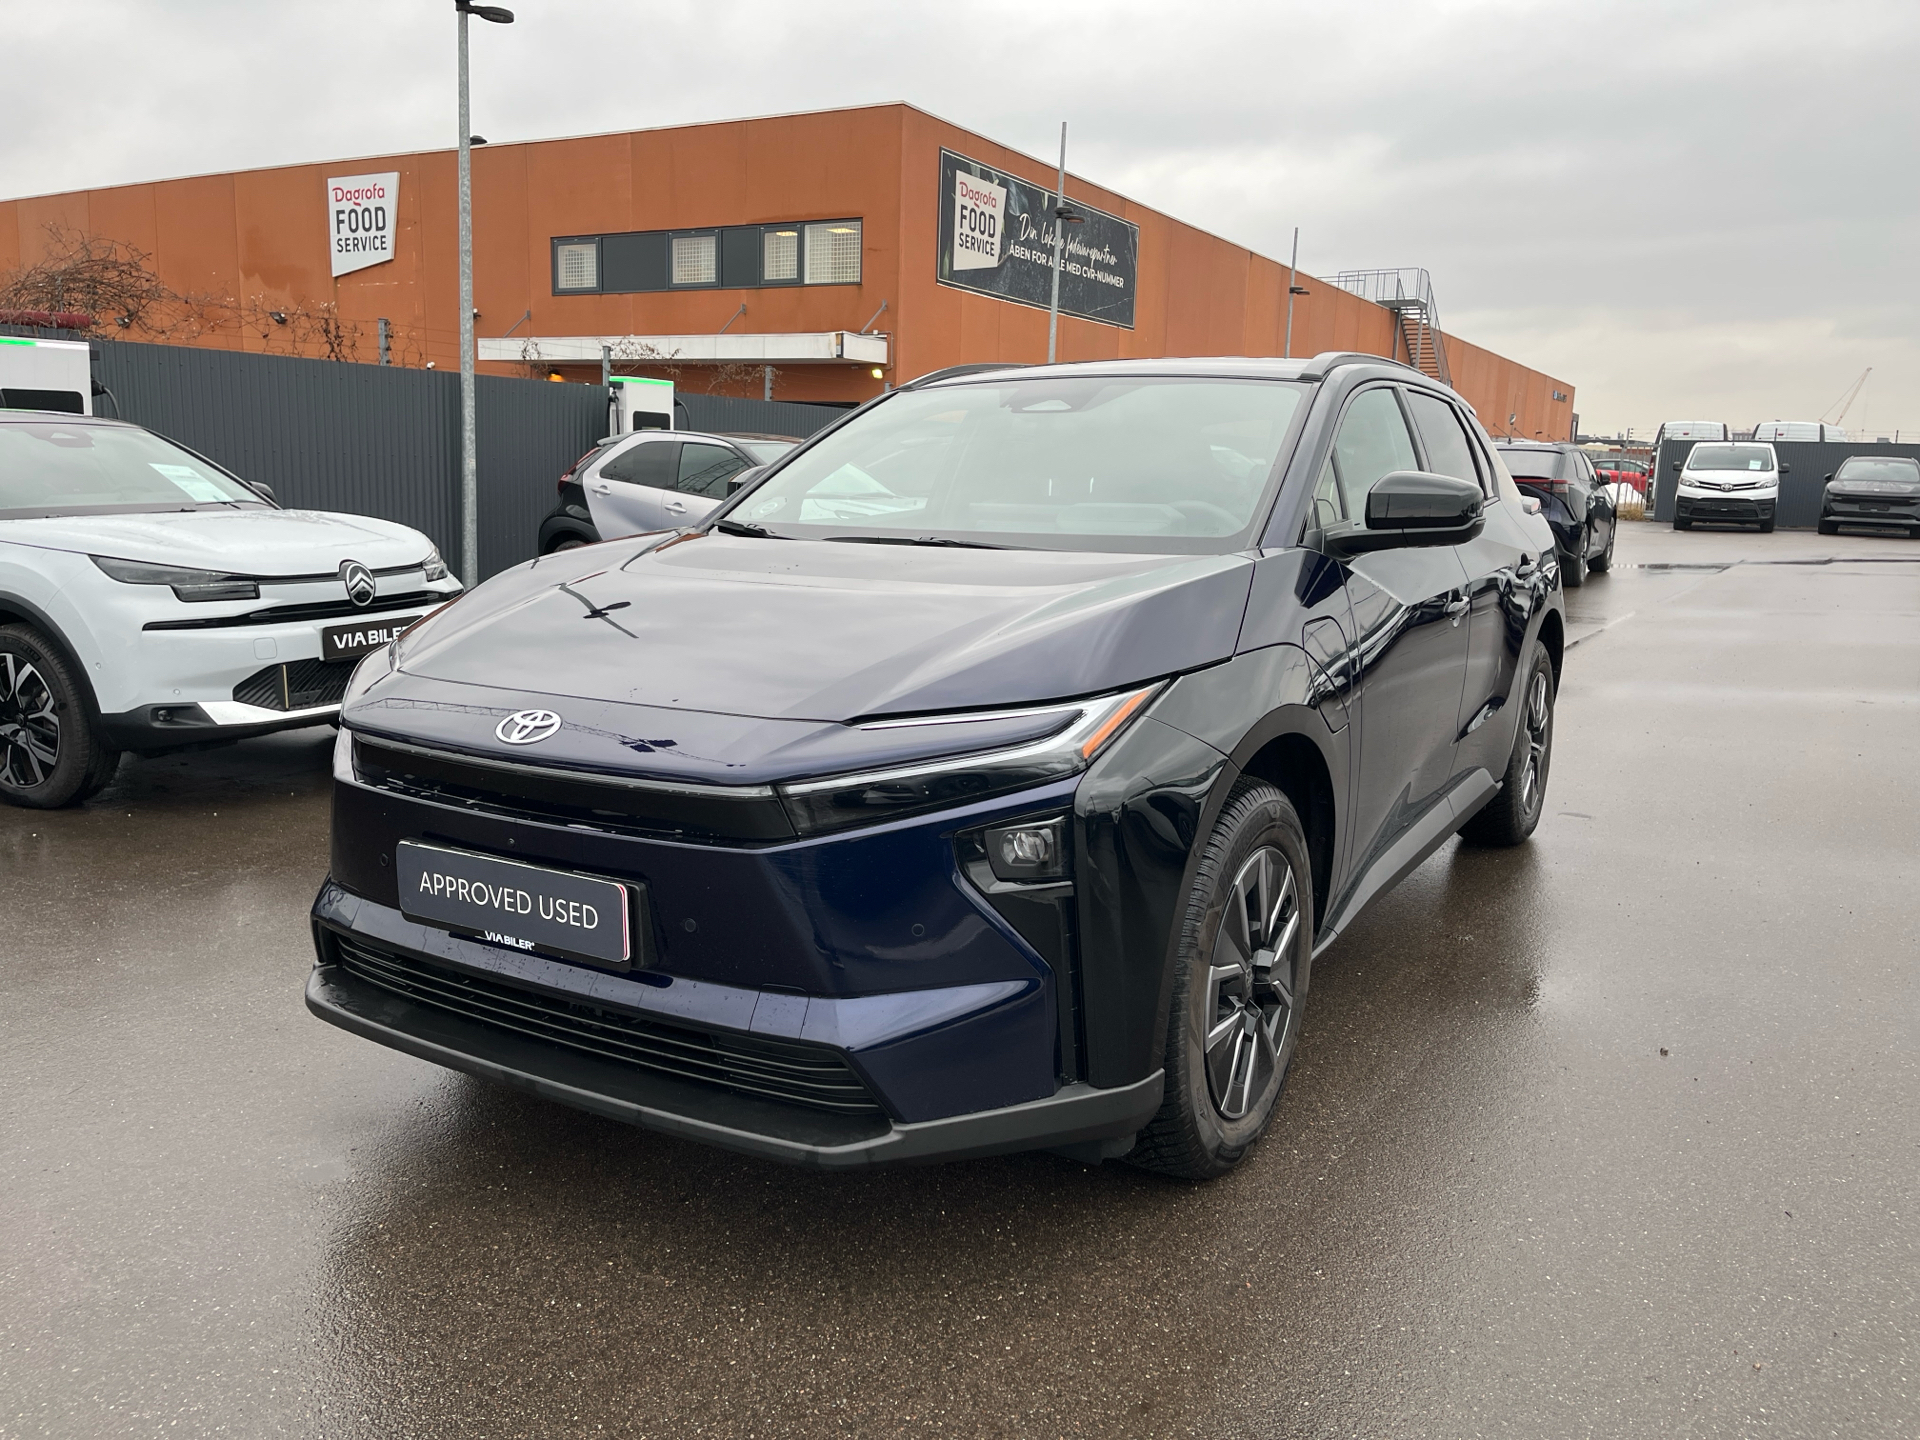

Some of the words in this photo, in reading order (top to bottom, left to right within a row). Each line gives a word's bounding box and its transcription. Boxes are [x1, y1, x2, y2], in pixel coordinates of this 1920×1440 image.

[332, 182, 386, 207] Dagrofa
[959, 181, 997, 209] Dagrofa
[335, 206, 387, 235] FOOD
[960, 204, 996, 239] FOOD
[1019, 213, 1038, 241] Din
[336, 235, 387, 253] SERVICE
[959, 232, 995, 257] SERVICE
[1009, 240, 1031, 261] ÅBEN
[1031, 250, 1048, 265] FOR
[1048, 256, 1066, 271] AE
[1066, 261, 1081, 276] MED
[1082, 266, 1125, 289] CVR-NUMMER
[419, 871, 532, 914] APPROVED
[539, 894, 599, 930] USED
